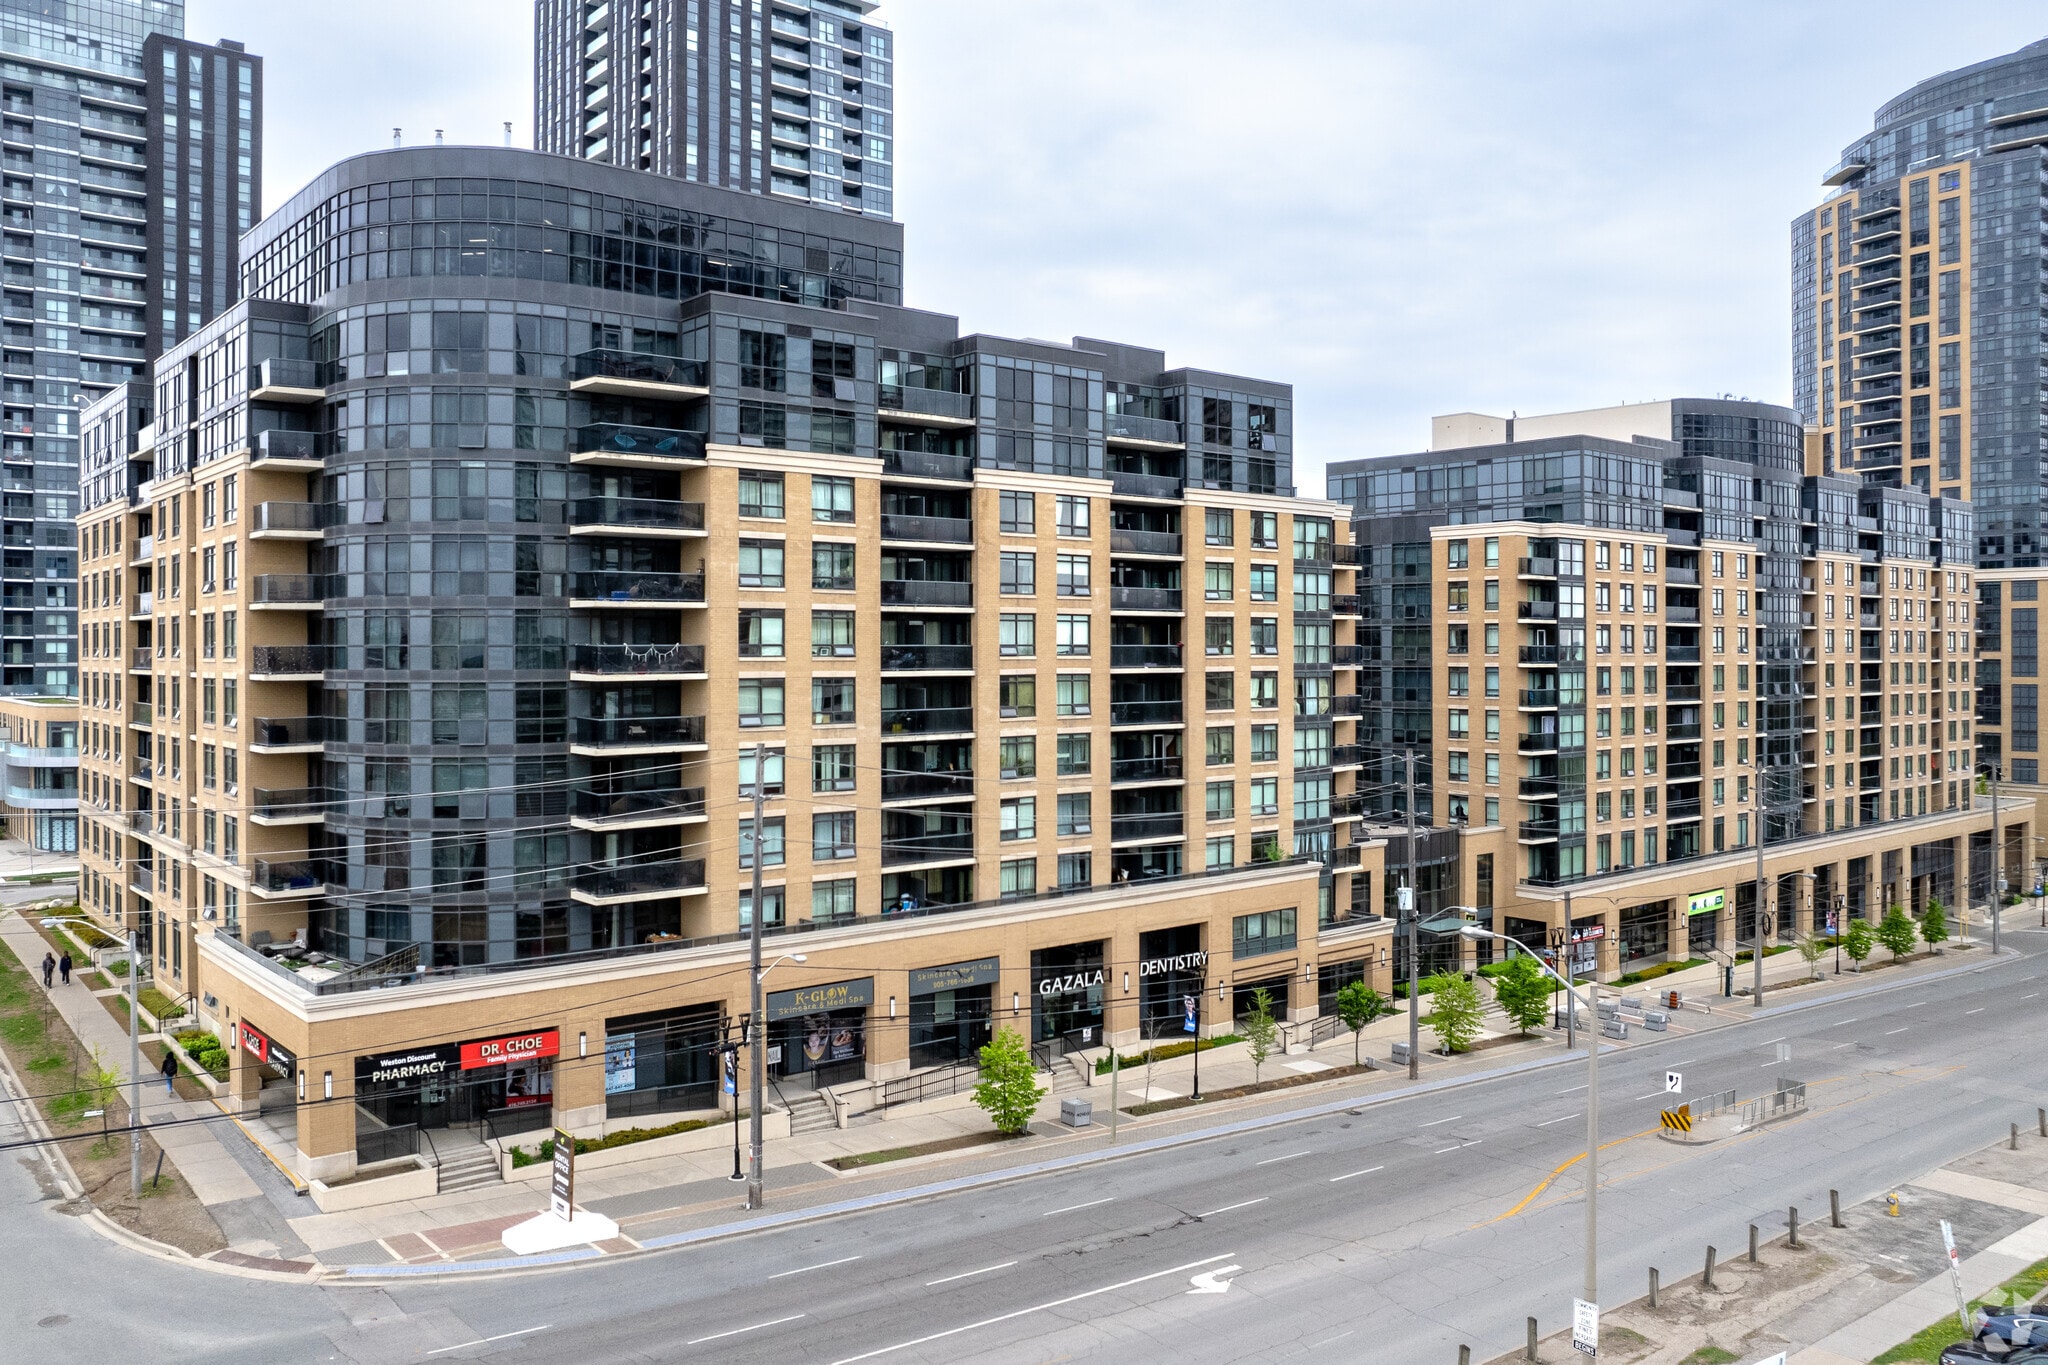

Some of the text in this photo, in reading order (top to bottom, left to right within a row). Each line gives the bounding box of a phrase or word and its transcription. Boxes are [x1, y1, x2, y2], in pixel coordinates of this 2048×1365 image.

[1140, 950, 1209, 977] DENTISTRY
[1039, 969, 1104, 995] GAZALA
[795, 985, 849, 1006] K-GLOW
[778, 1003, 817, 1016] Skincare
[826, 997, 847, 1007] Medi
[848, 995, 864, 1004] Spa
[481, 1036, 543, 1057] DR. CHOE
[380, 1052, 437, 1067] Weston Discount
[487, 1050, 537, 1063] Family Physician
[372, 1060, 446, 1083] PHARMACY
[554, 1151, 570, 1167] RENTAL
[554, 1161, 569, 1175] OFFICE
[1579, 1310, 1593, 1318] SAFETY
[1575, 1341, 1594, 1355] BEGINS
